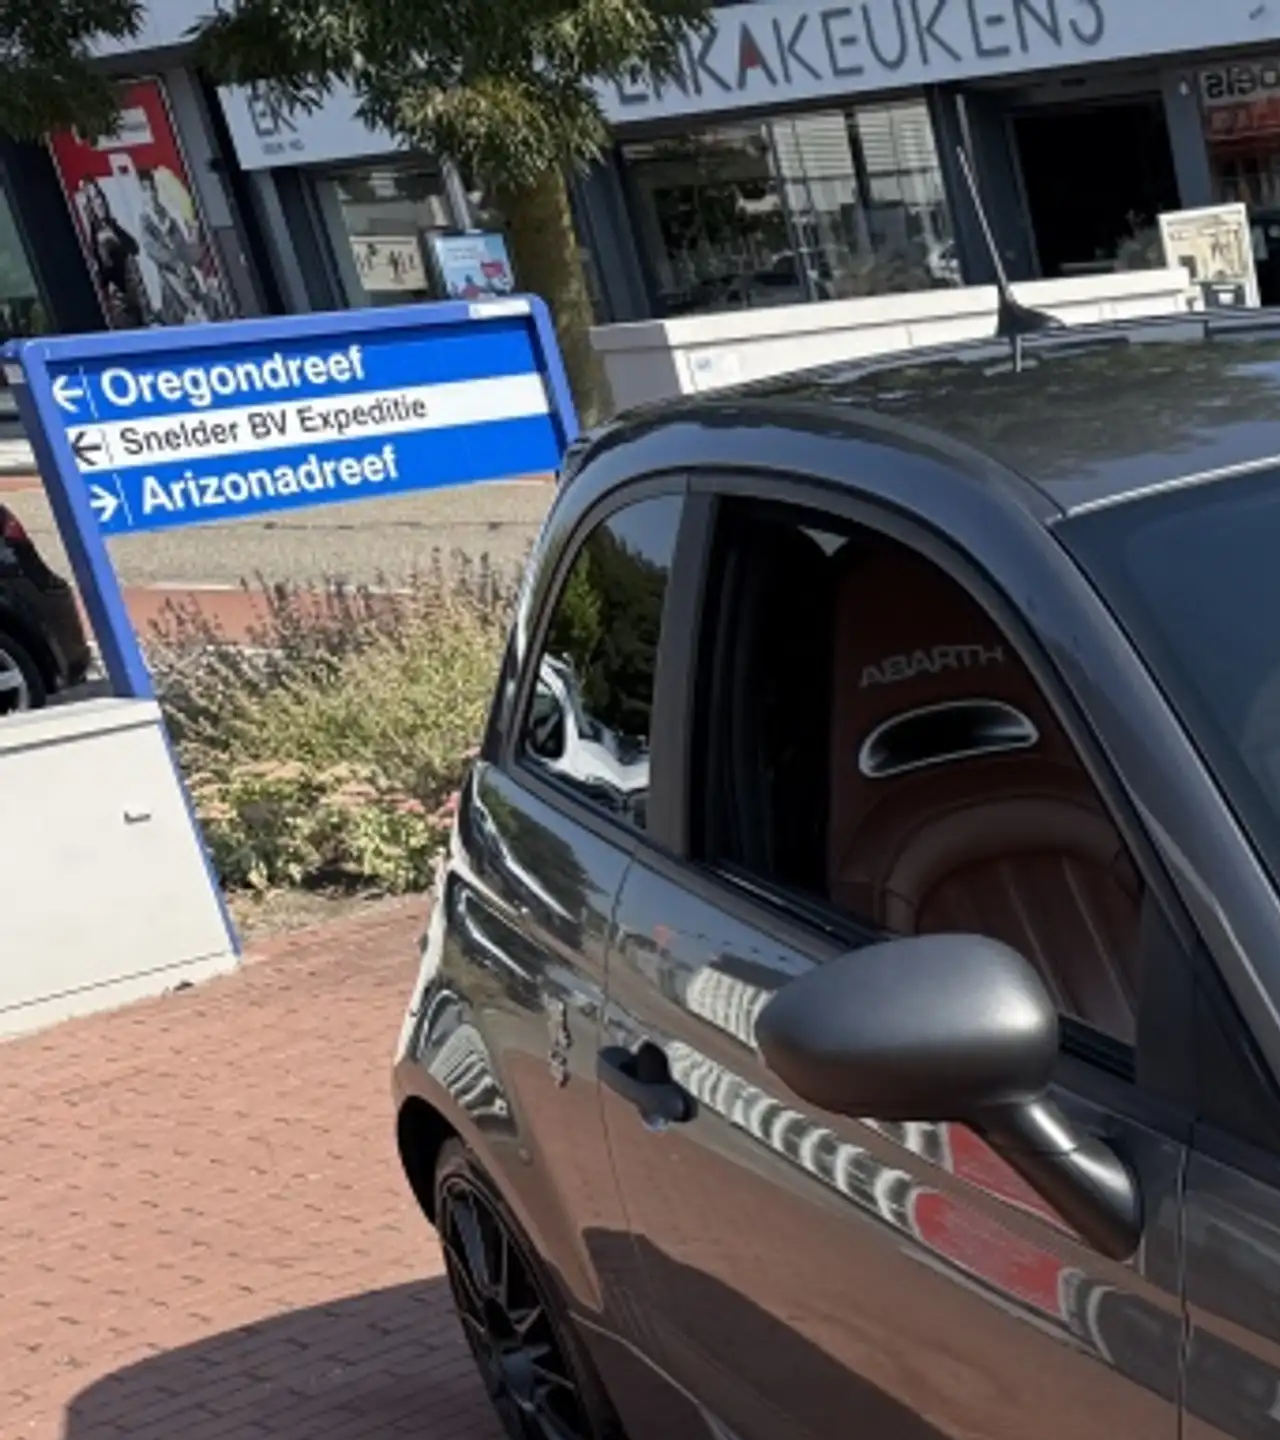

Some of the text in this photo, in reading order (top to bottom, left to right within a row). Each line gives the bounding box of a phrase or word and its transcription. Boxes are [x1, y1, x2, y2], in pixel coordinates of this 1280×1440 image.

[101, 344, 366, 407] Oregondreef
[119, 394, 428, 456] Snelder BV Expeditie
[141, 443, 400, 515] Arizonadreef
[858, 644, 1004, 688] ABARTH
